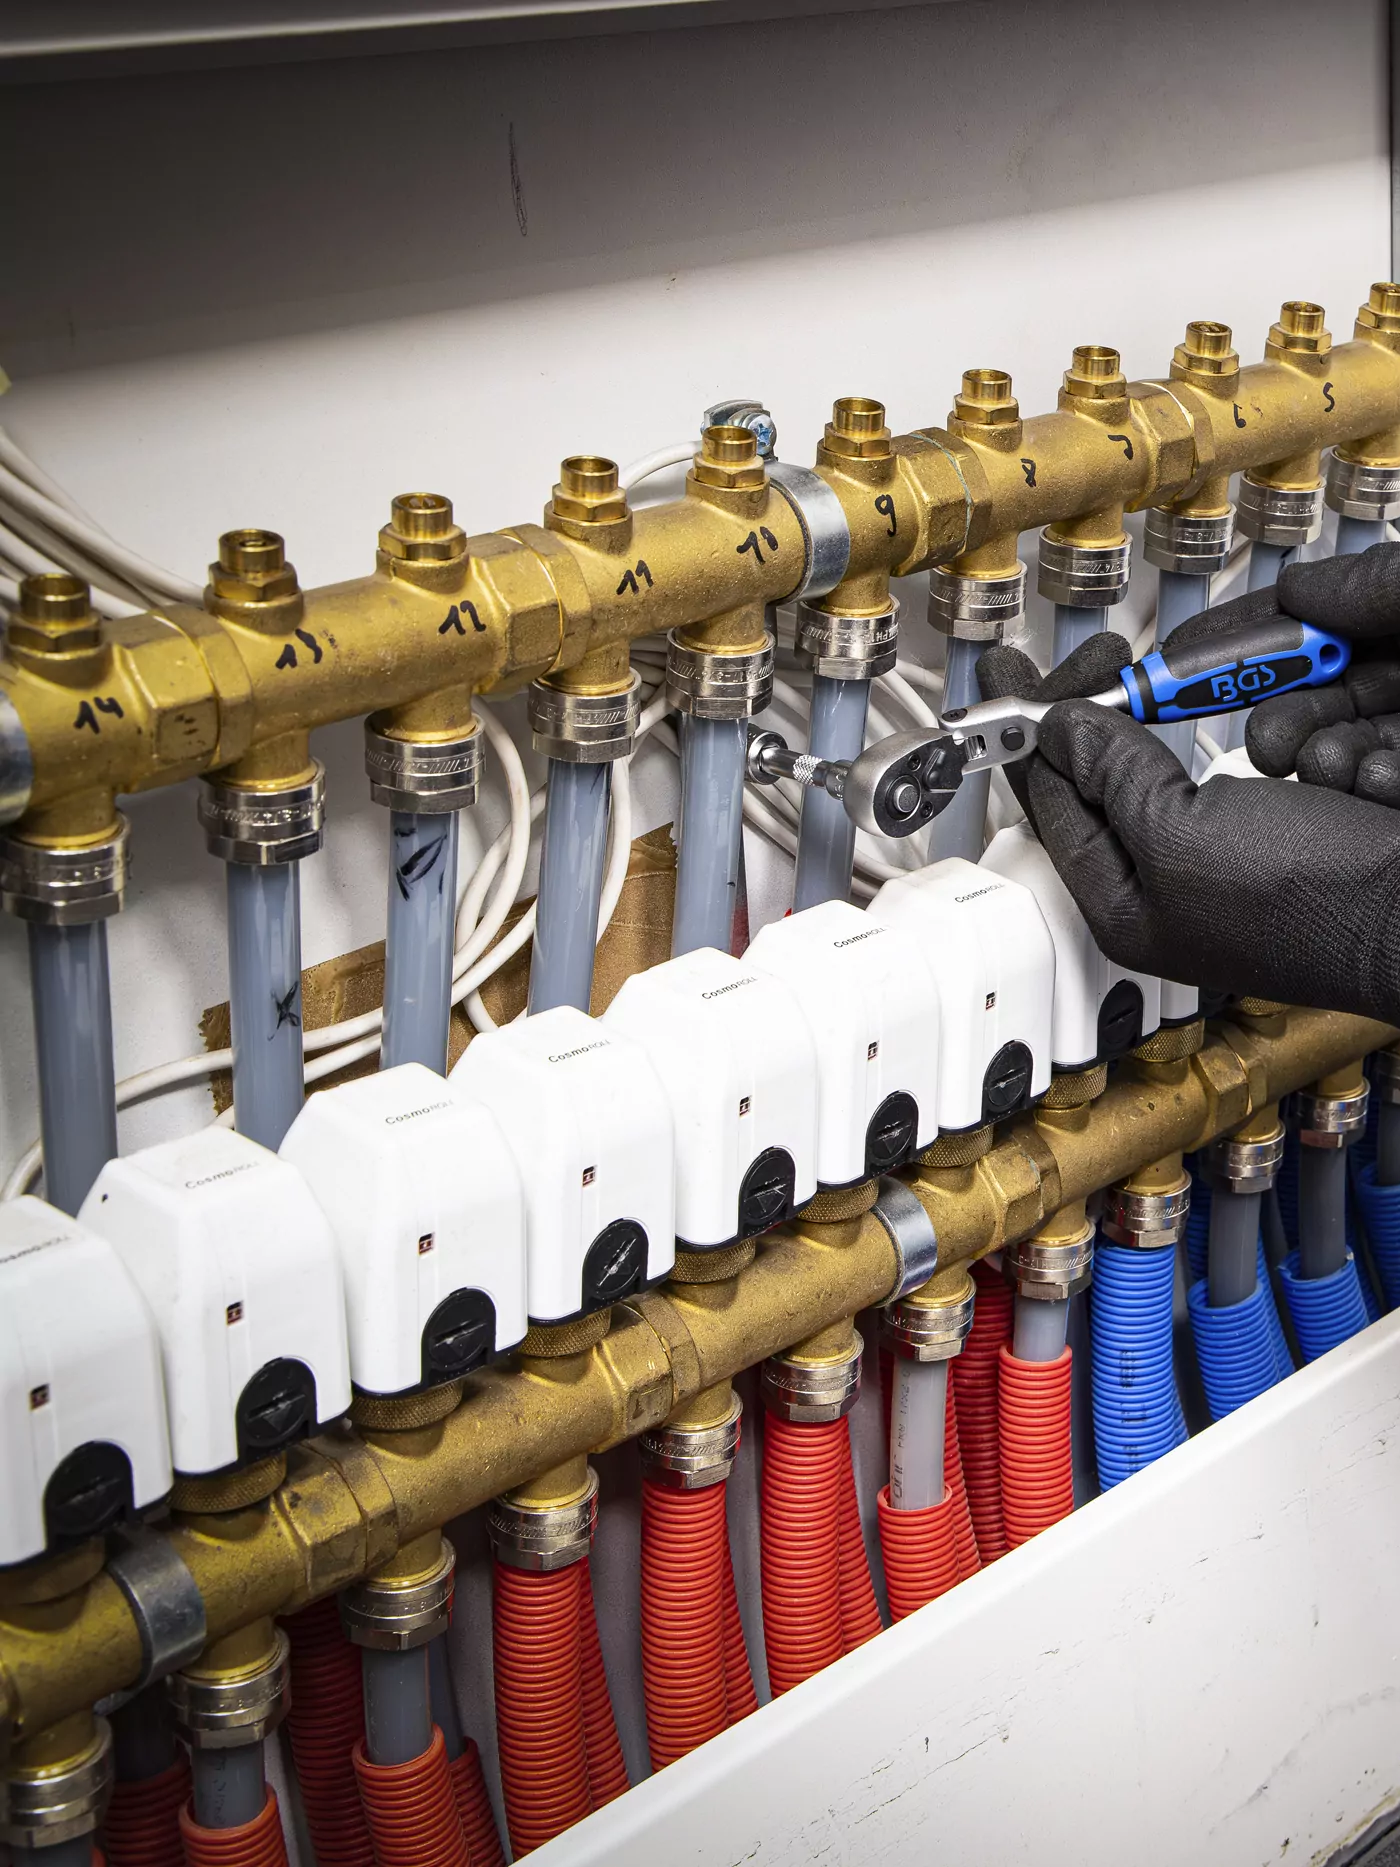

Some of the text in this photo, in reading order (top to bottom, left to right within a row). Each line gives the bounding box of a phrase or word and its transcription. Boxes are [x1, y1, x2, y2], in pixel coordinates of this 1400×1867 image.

[1323, 382, 1335, 413] 5
[874, 494, 897, 537] 9
[616, 559, 654, 595] 11
[1210, 664, 1277, 702] BGS
[73, 696, 124, 734] 14
[833, 926, 887, 949] CosmoROLL
[701, 976, 759, 1000] CosmoROLL
[548, 1038, 612, 1064] CosmoROLL
